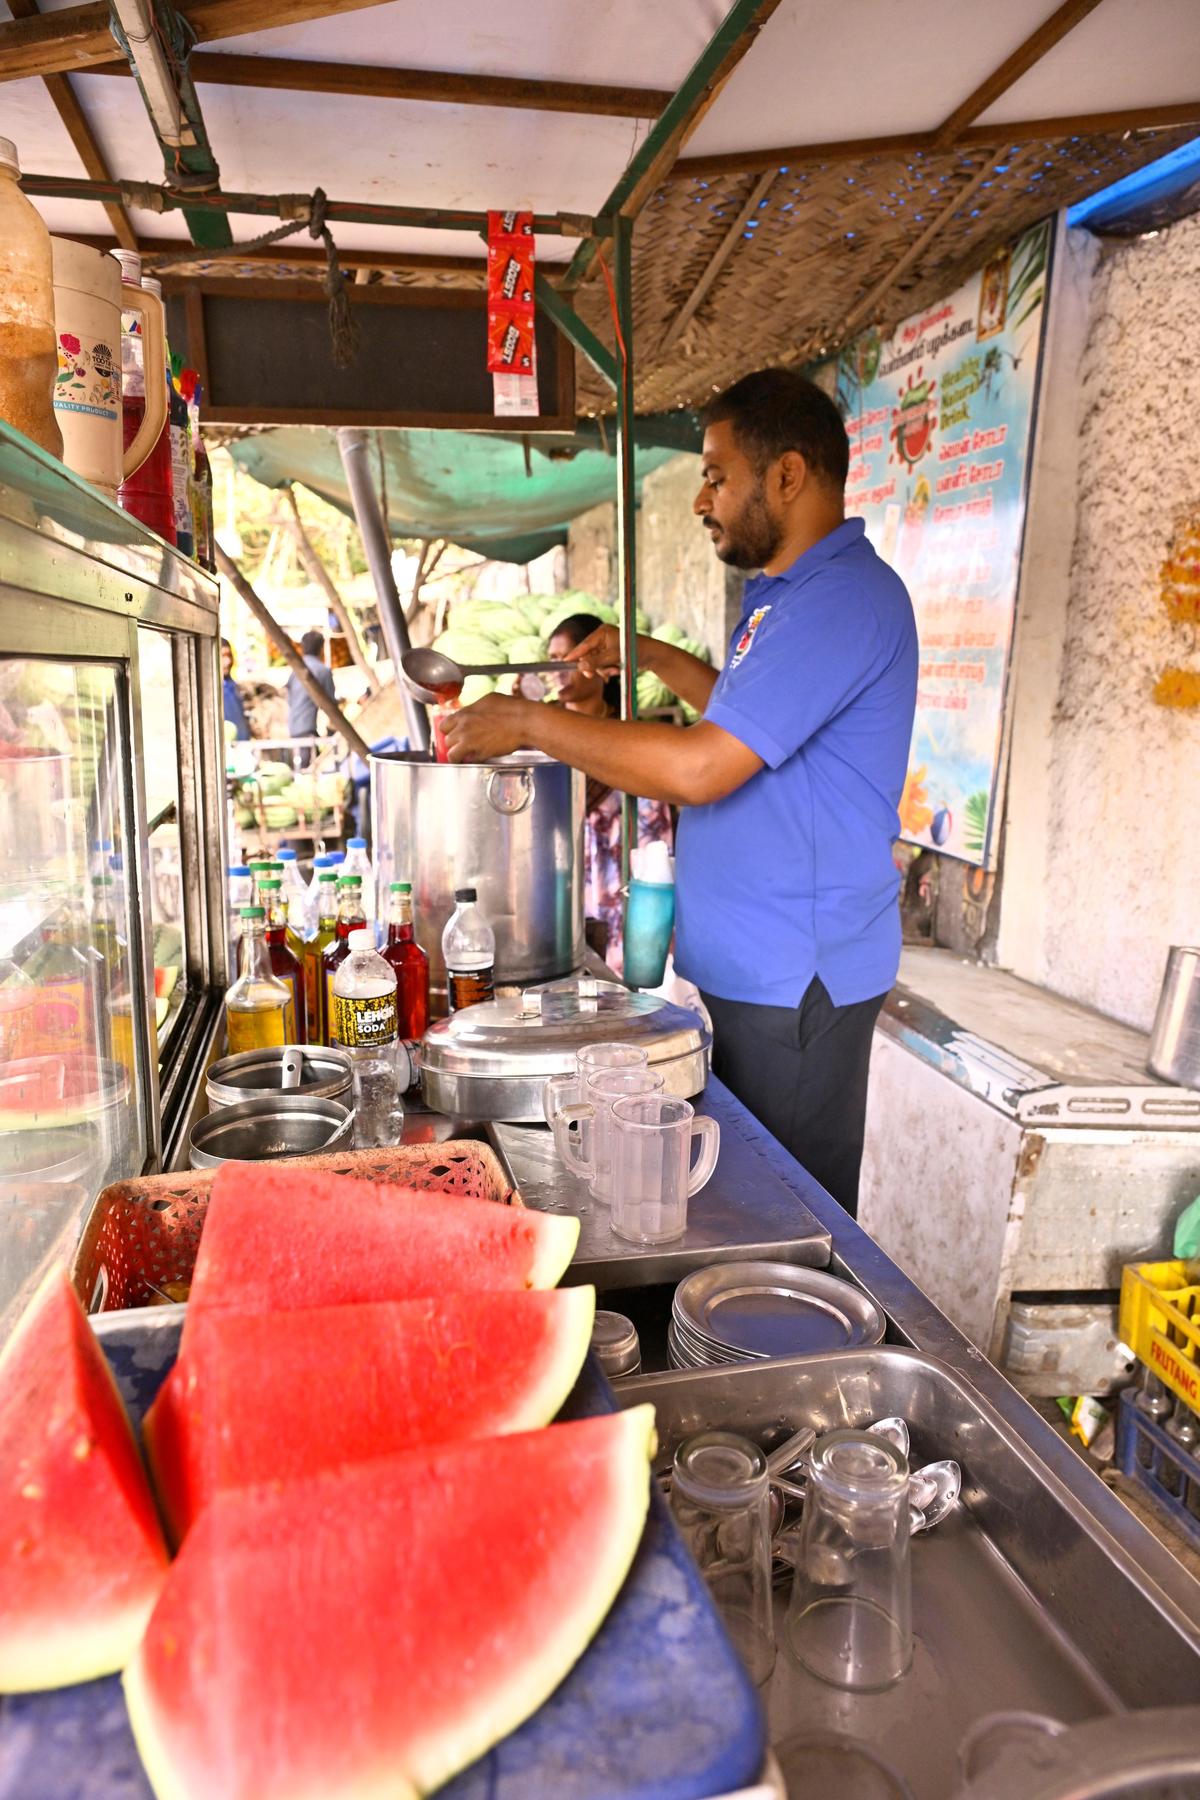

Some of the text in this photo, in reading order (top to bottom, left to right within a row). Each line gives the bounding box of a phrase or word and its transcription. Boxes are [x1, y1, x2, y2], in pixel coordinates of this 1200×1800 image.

[503, 259, 521, 299] BOOST
[503, 325, 520, 364] BOOST
[54, 402, 80, 411] UALITY
[972, 426, 1007, 452] சோடா
[968, 461, 1004, 484] சோடா
[356, 1005, 395, 1022] LEMON
[357, 1023, 386, 1033] SODA
[1151, 1340, 1197, 1399] FRUTANG
